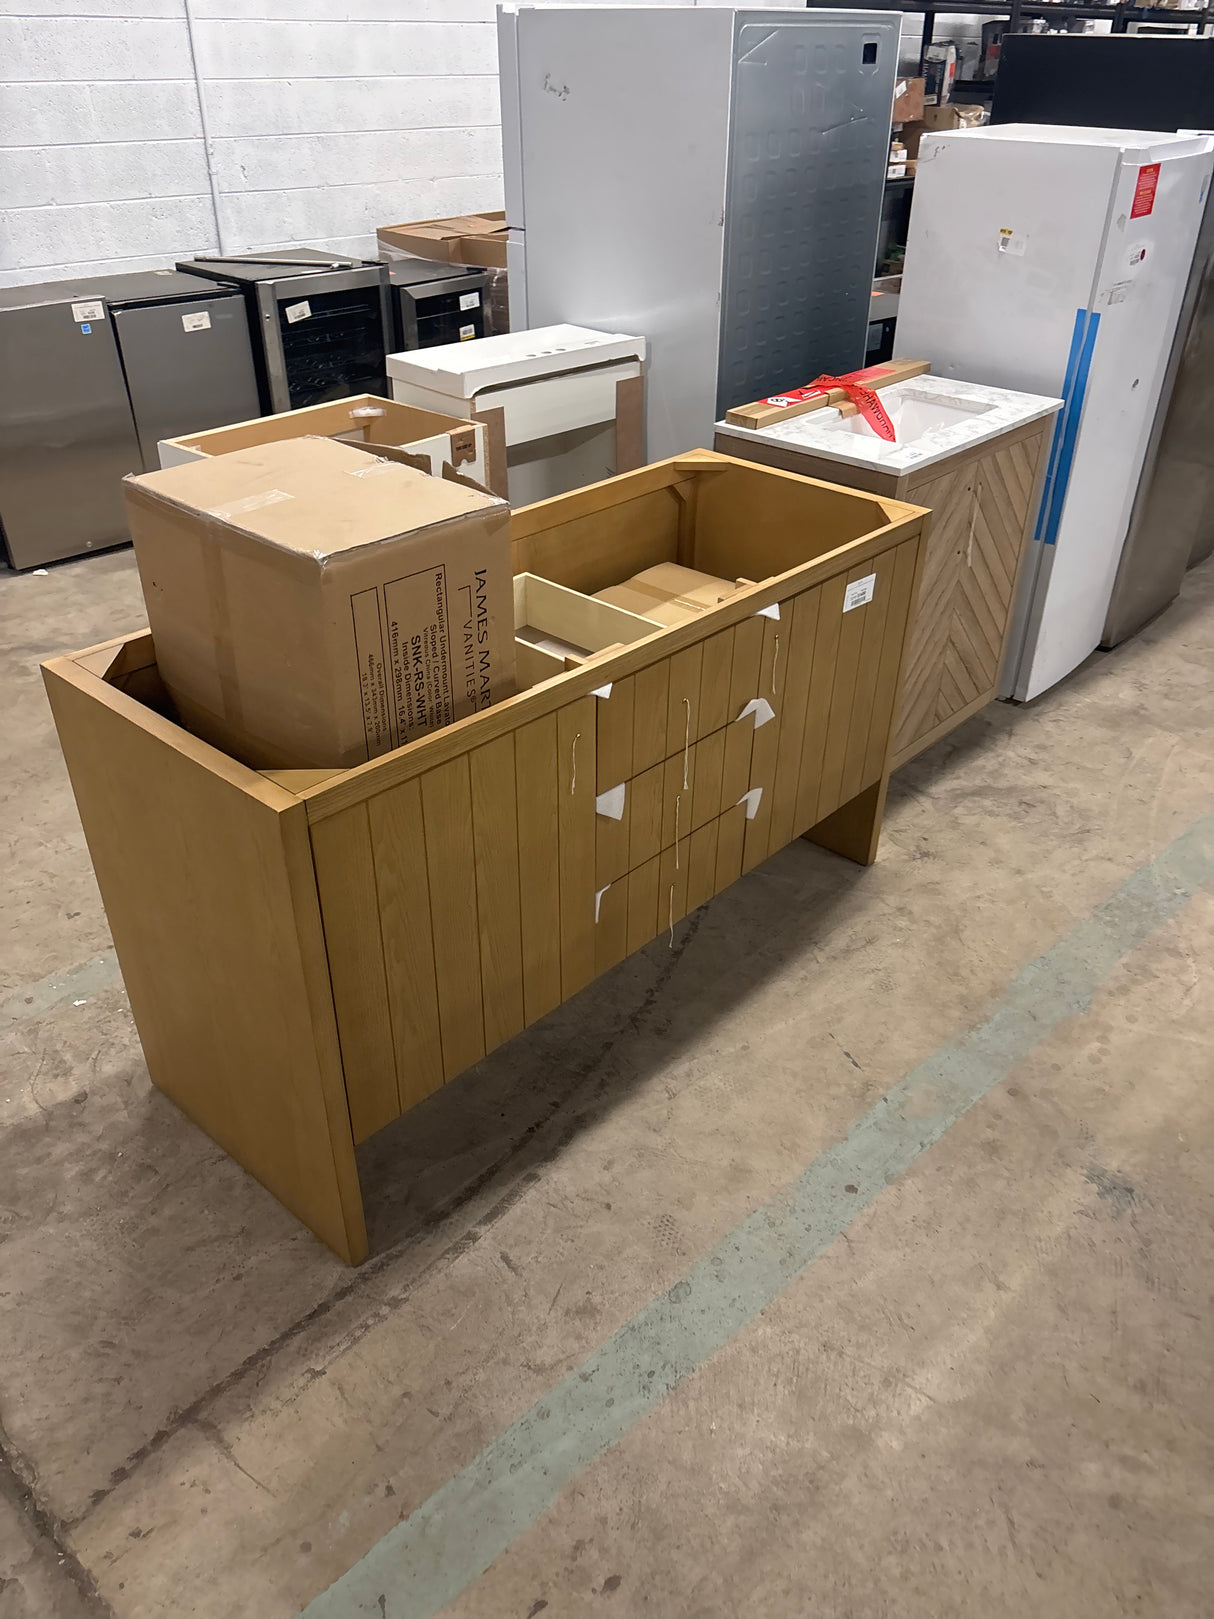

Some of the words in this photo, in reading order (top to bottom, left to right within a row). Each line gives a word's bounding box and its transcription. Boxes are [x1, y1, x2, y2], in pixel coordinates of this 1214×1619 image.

[435, 572, 445, 634] Rectangular
[474, 569, 488, 645] JAMES
[390, 621, 399, 657] 416mm
[402, 641, 410, 671] Inside
[430, 624, 438, 658] Sloped
[410, 634, 427, 726] SNK-RS-WHT
[433, 665, 441, 699] Curved
[439, 635, 449, 695] Undermount
[394, 667, 403, 702] 298mm
